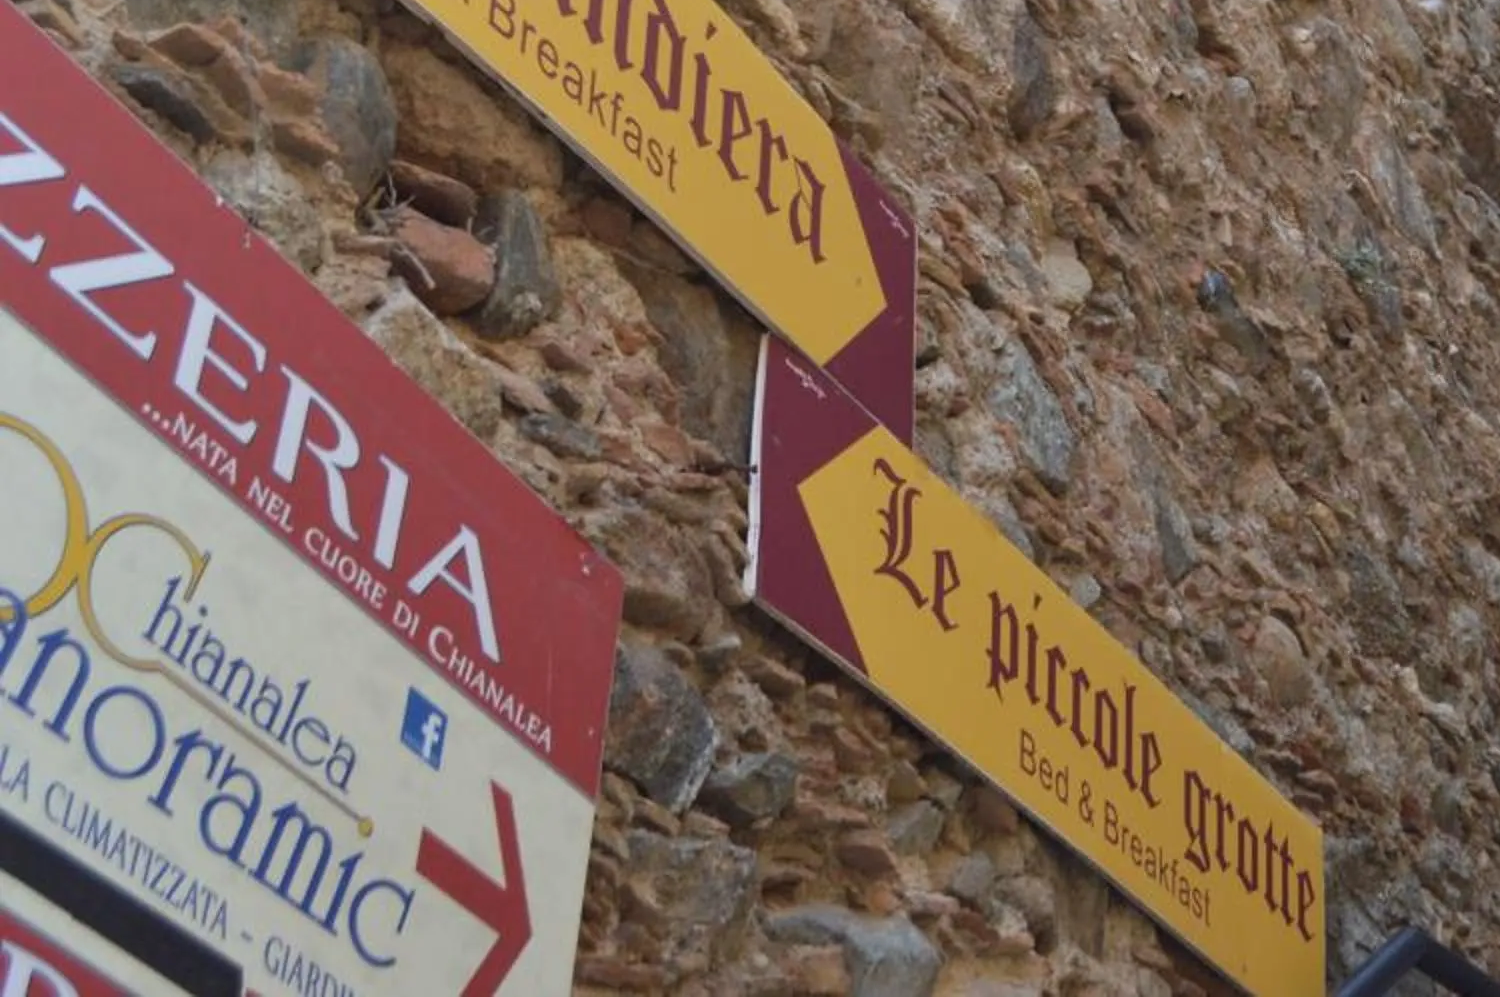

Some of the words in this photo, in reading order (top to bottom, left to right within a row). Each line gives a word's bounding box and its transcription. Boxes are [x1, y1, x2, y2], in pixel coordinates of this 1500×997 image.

[77, 512, 358, 796] Chianalea
[246, 475, 295, 534] NEL
[304, 527, 388, 611] CUORE
[393, 598, 420, 639] DI
[873, 457, 962, 633] Le
[984, 591, 1164, 810] piccole
[1182, 769, 1317, 943] grotte
[44, 781, 228, 941] CLIMATIZZATA
[1018, 728, 1070, 805] Bed
[1080, 785, 1096, 829] &
[1103, 799, 1213, 928] Breakfast
